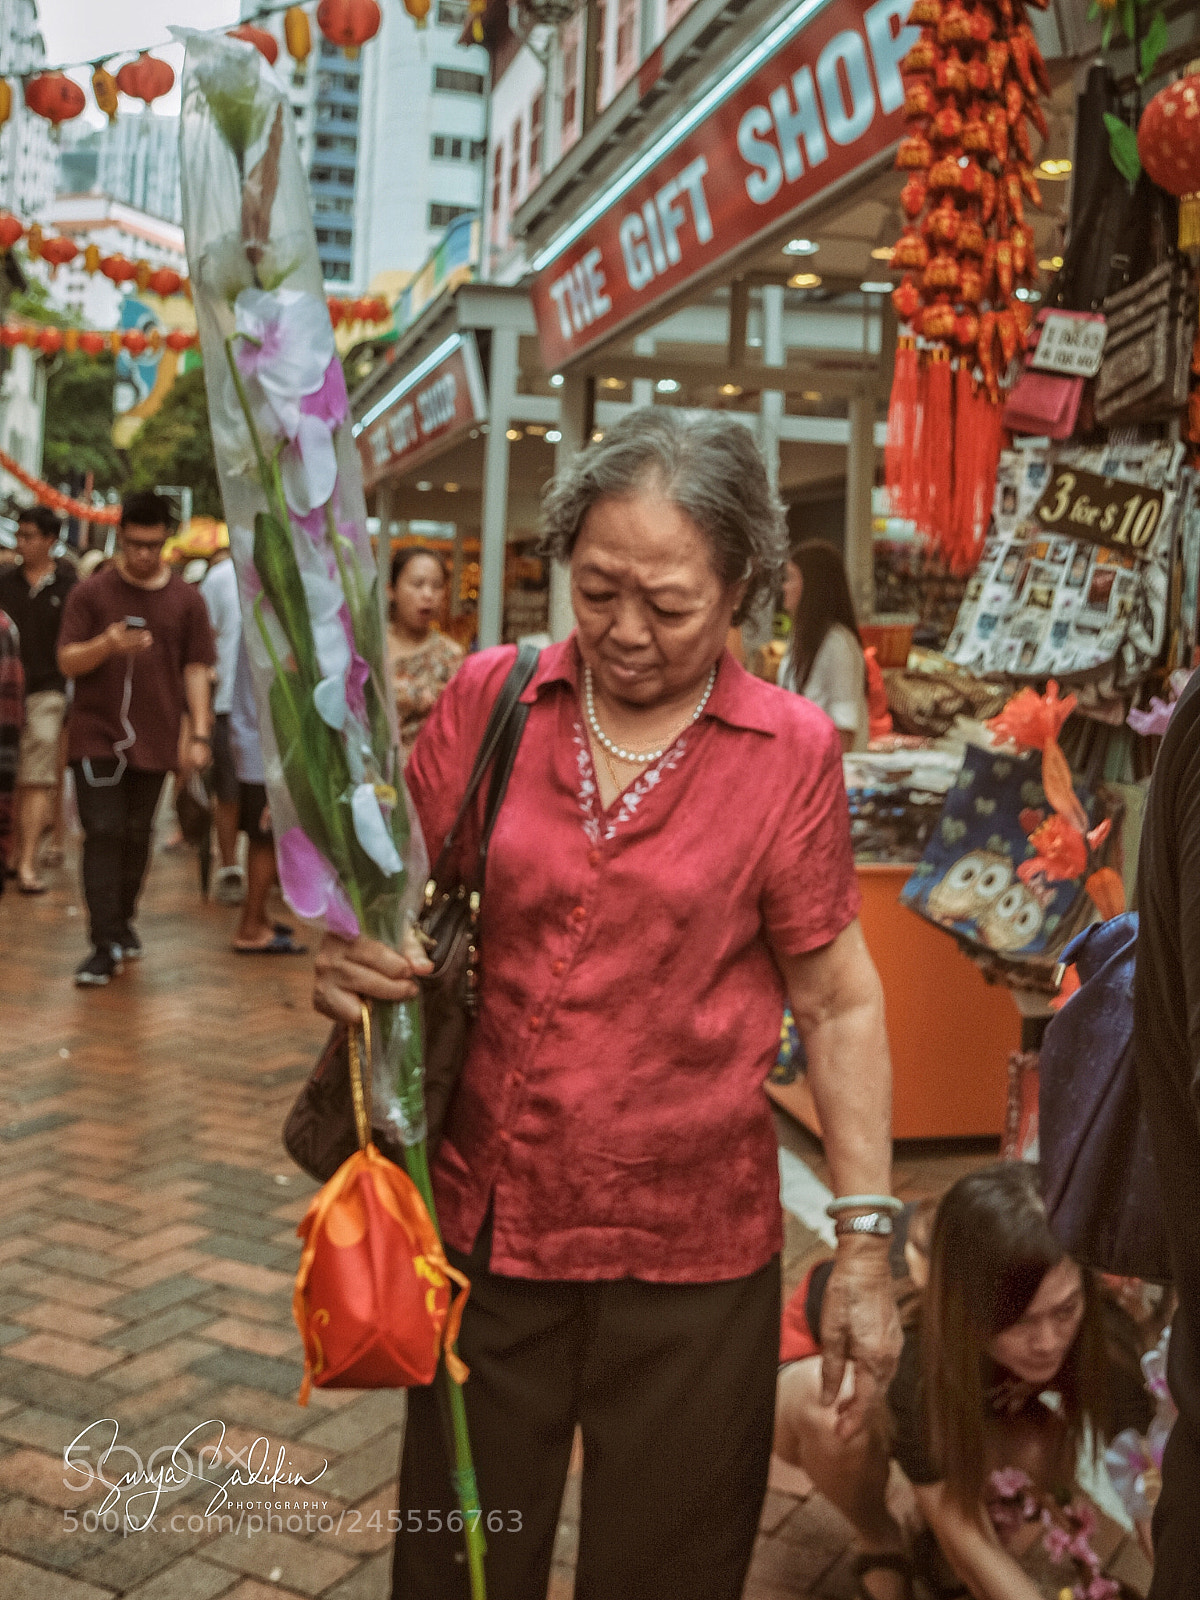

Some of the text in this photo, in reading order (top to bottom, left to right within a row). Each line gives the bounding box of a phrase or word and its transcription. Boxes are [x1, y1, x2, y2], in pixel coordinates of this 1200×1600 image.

[548, 0, 922, 340] THE GIFT SHOP
[1038, 472, 1077, 523] 3
[1069, 495, 1099, 525] for
